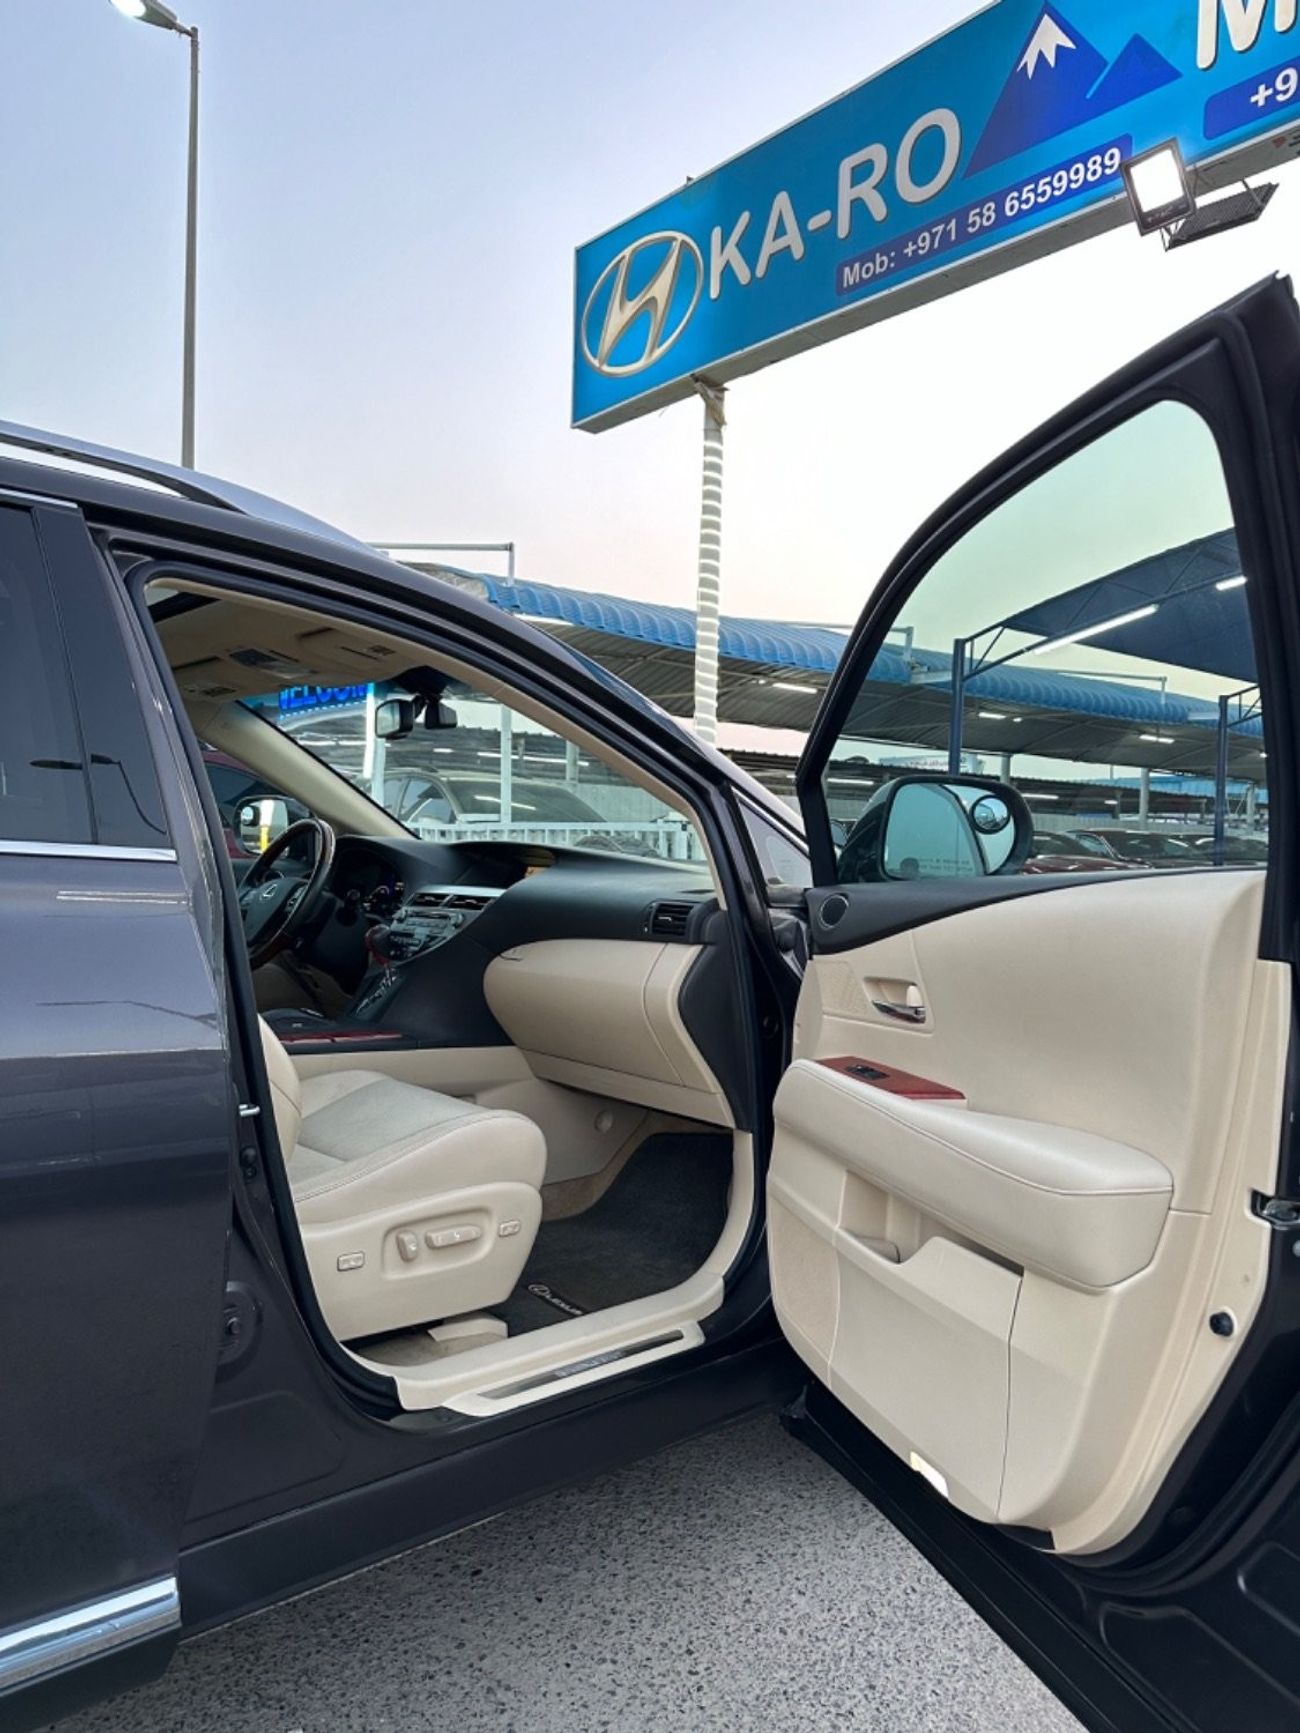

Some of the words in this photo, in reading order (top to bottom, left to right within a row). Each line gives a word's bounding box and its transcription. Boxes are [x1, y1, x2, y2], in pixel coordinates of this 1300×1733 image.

[709, 108, 961, 300] KA-RO
[842, 252, 895, 288] Mob:
[903, 219, 957, 258] +971
[967, 202, 995, 233] 58
[1004, 147, 1121, 217] 6559989
